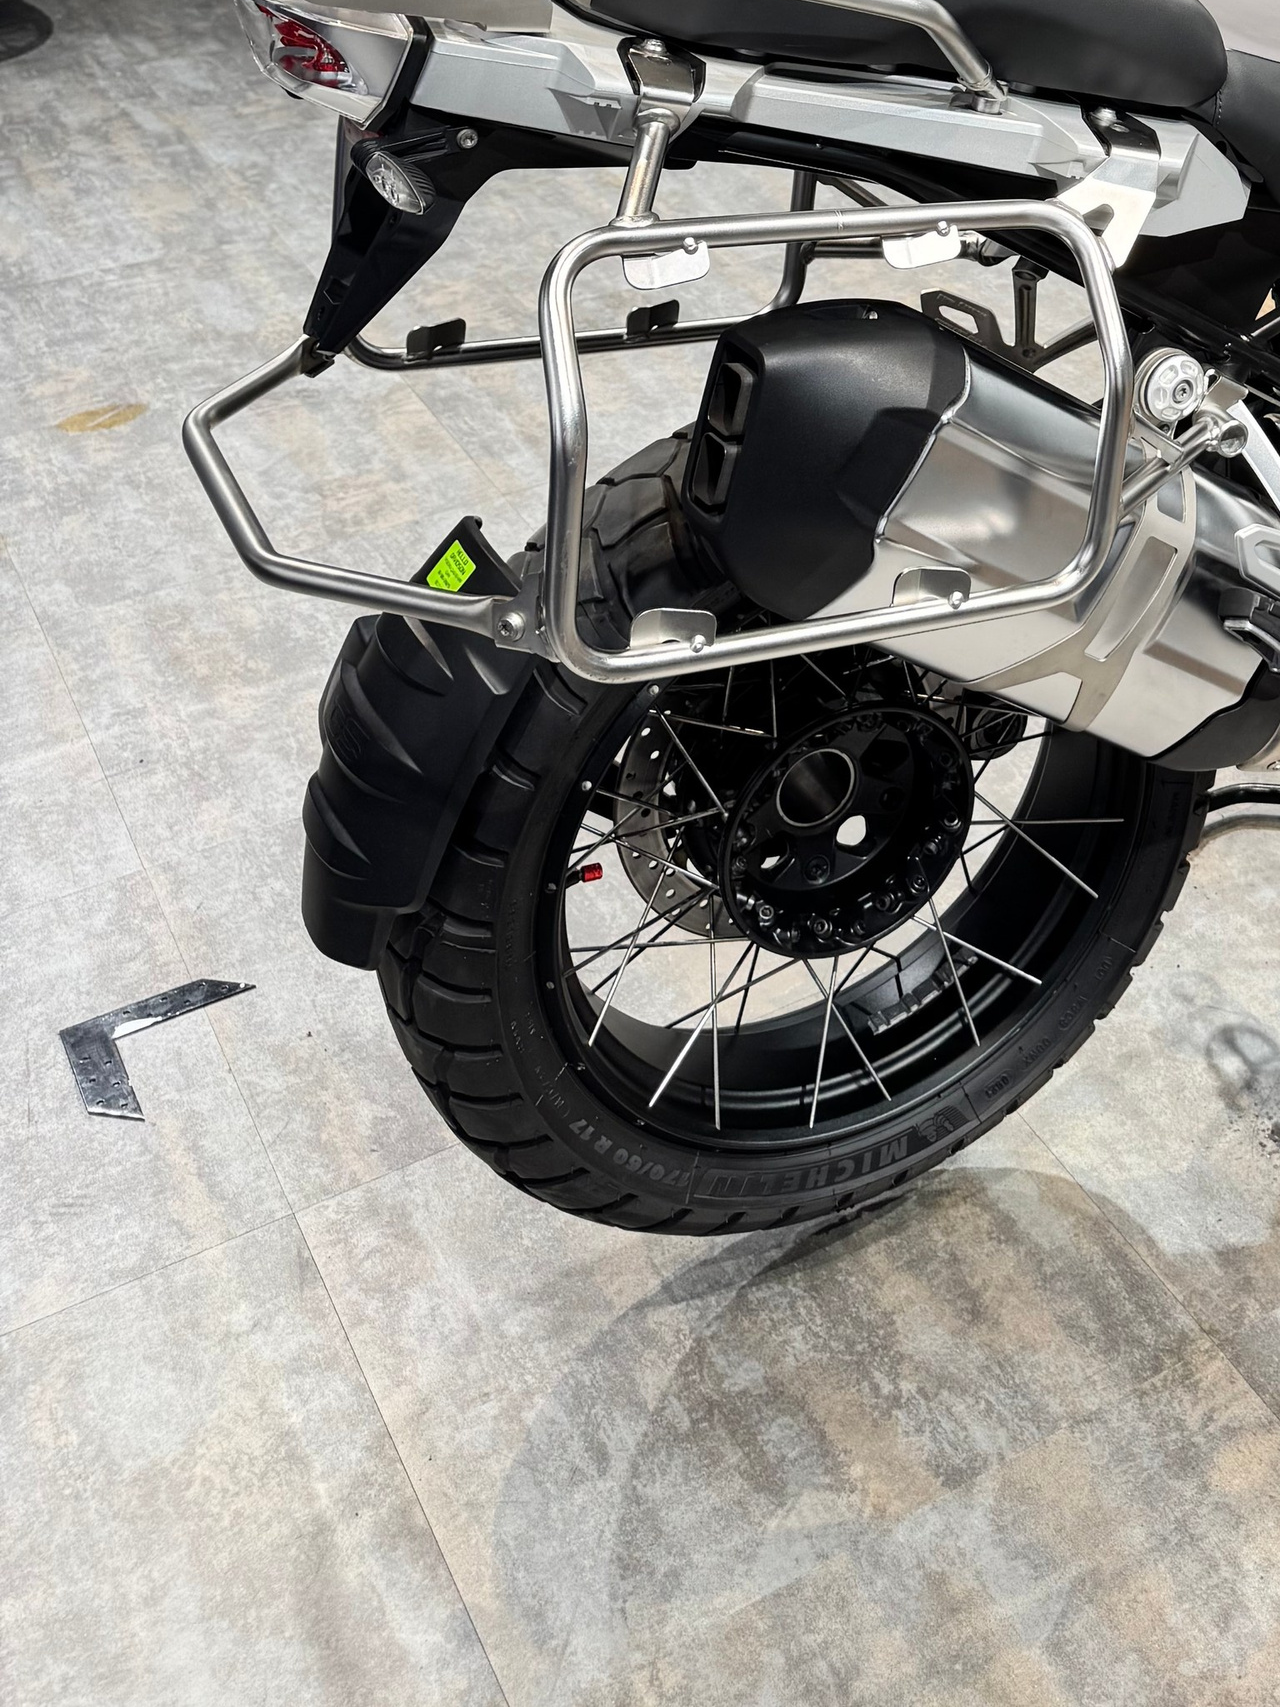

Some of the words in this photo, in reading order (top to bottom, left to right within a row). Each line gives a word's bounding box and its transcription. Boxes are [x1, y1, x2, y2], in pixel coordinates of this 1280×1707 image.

[567, 1117, 596, 1142] 17
[592, 1133, 613, 1155] R
[611, 1147, 692, 1188] 170/60
[706, 1138, 908, 1197] MICHELIN
